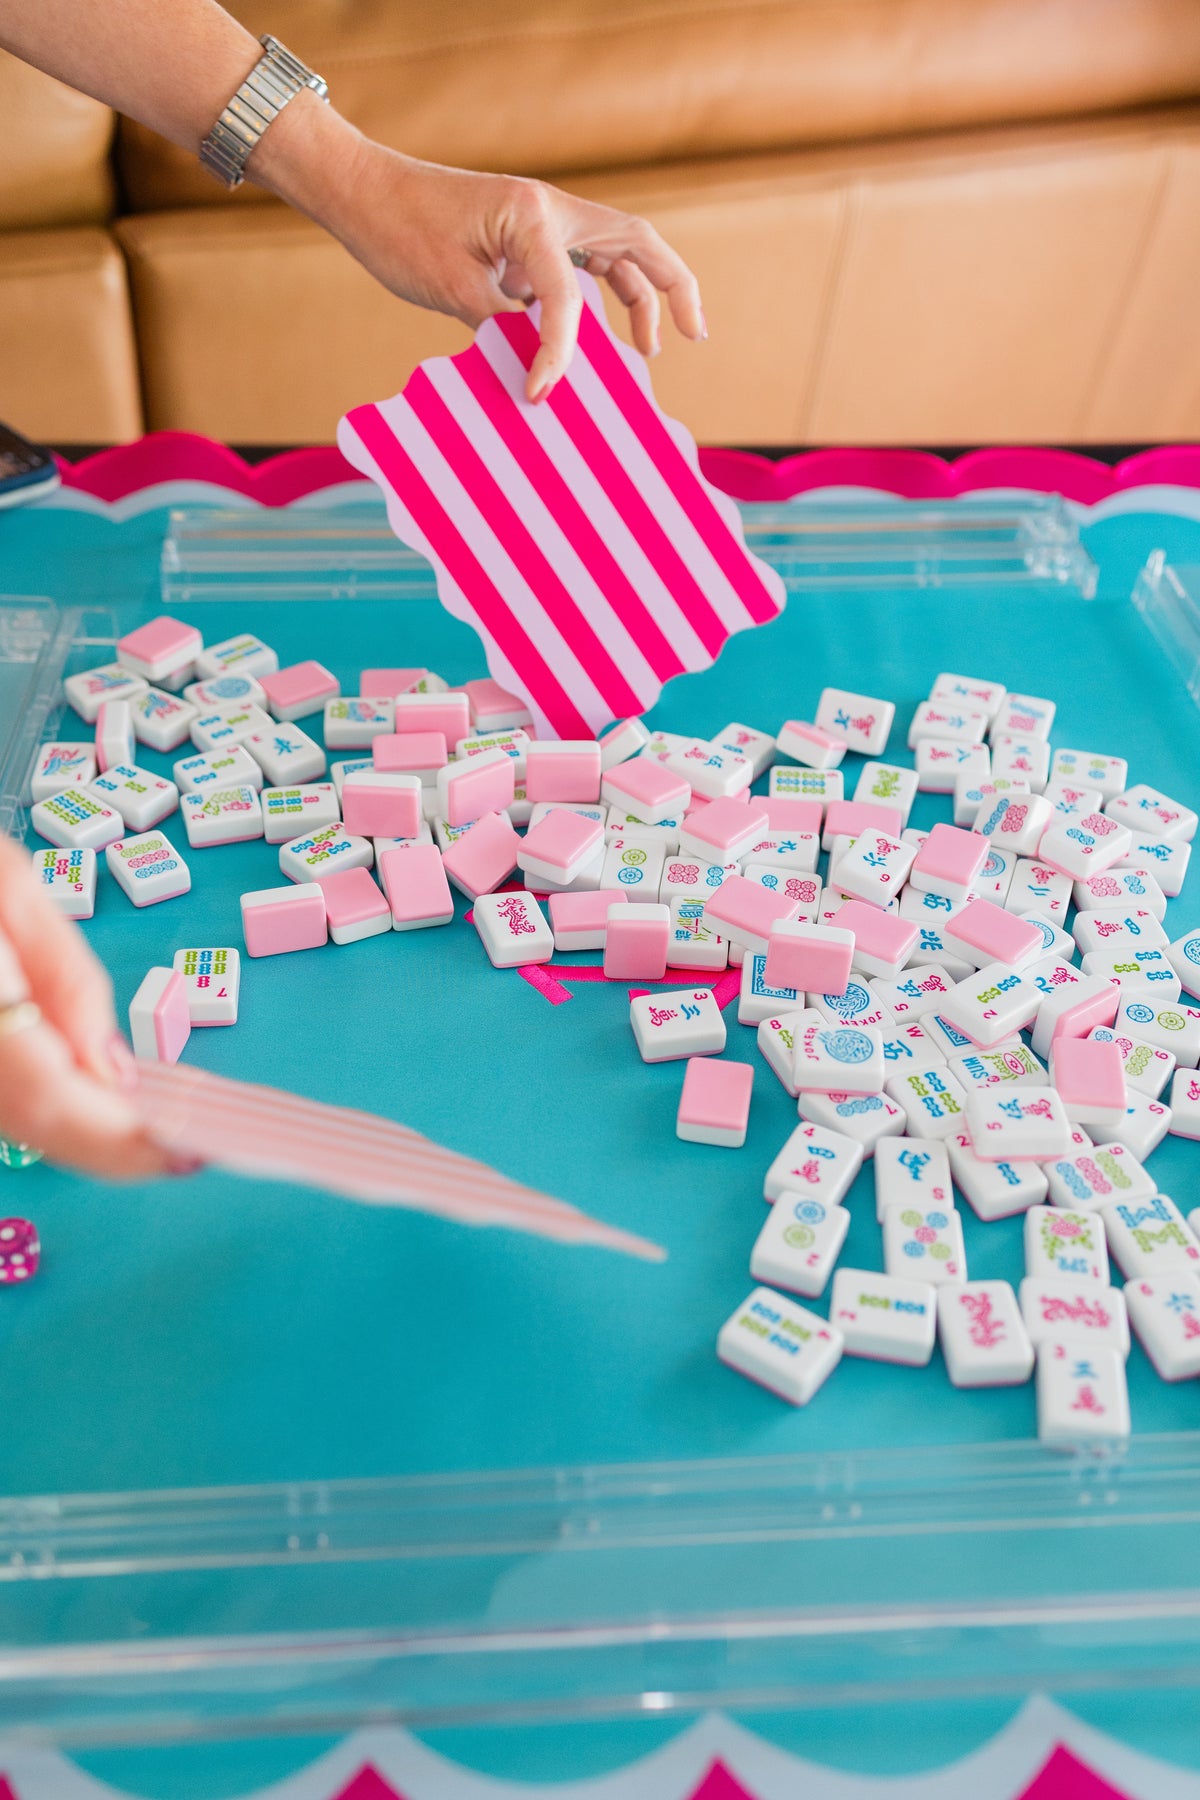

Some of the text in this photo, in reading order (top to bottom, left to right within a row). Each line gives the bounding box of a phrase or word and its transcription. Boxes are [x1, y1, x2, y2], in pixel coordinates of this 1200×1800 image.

[74, 883, 83, 892] 5
[1050, 901, 1060, 910] 2
[217, 988, 227, 997] 7
[1187, 1009, 1200, 1018] 2
[770, 1020, 781, 1029] 8
[803, 1026, 820, 1062] JOKER
[963, 1057, 988, 1078] SUM
[1149, 1104, 1164, 1114] S
[987, 1122, 1002, 1130] 5
[957, 1136, 969, 1147] 2
[1072, 1133, 1083, 1143] 8
